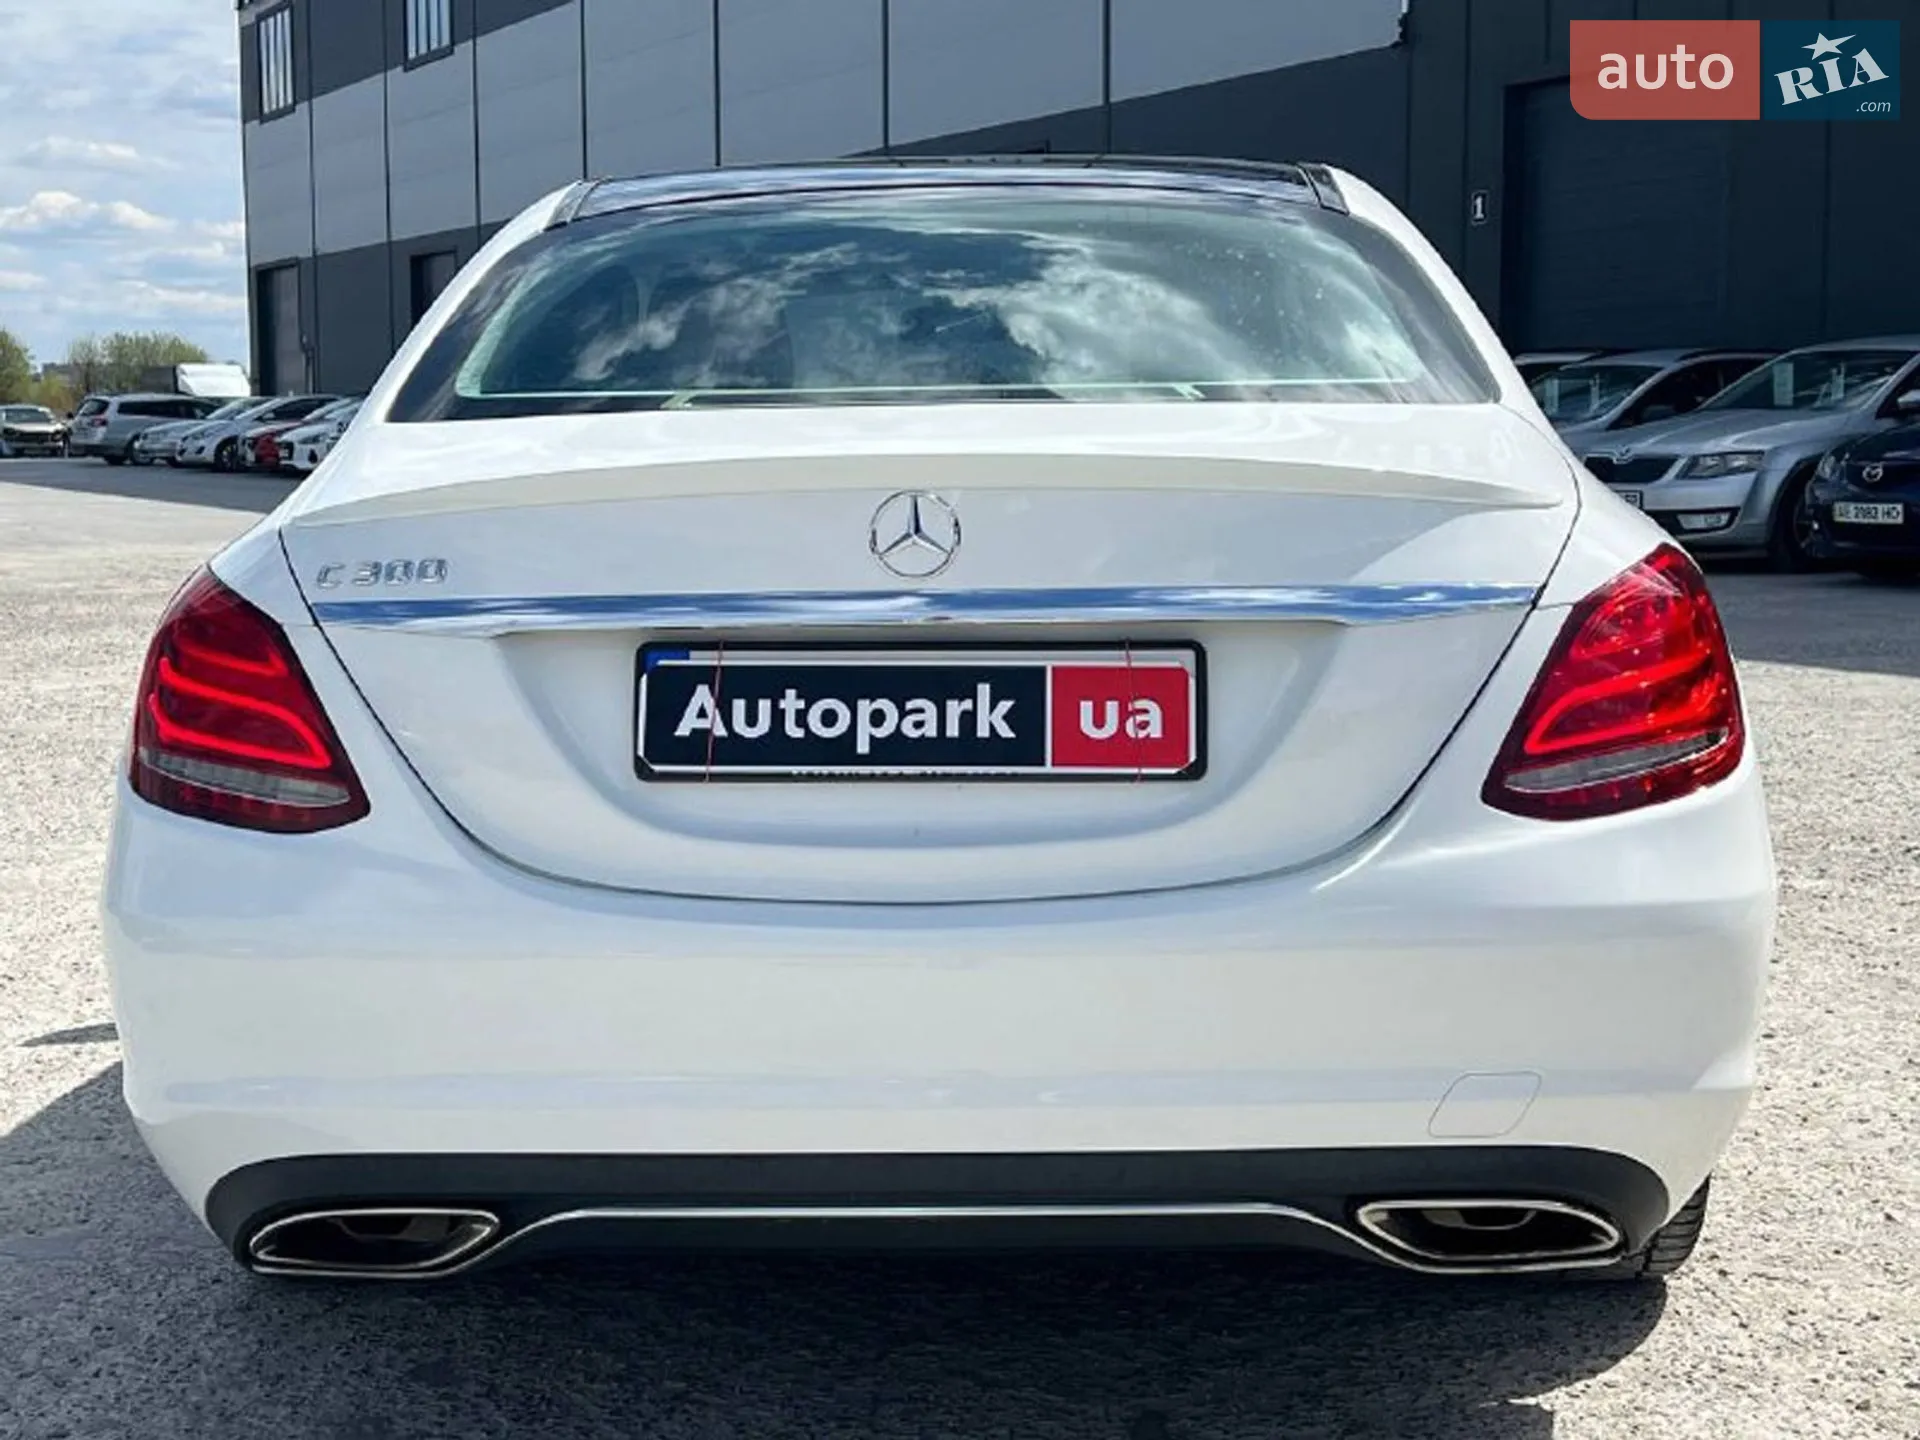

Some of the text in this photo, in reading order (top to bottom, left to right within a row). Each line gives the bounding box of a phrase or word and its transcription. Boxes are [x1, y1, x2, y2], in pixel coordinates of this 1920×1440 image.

[1475, 195, 1485, 219] 1
[316, 559, 448, 589] C 300
[674, 683, 1163, 754] Autopark ua
